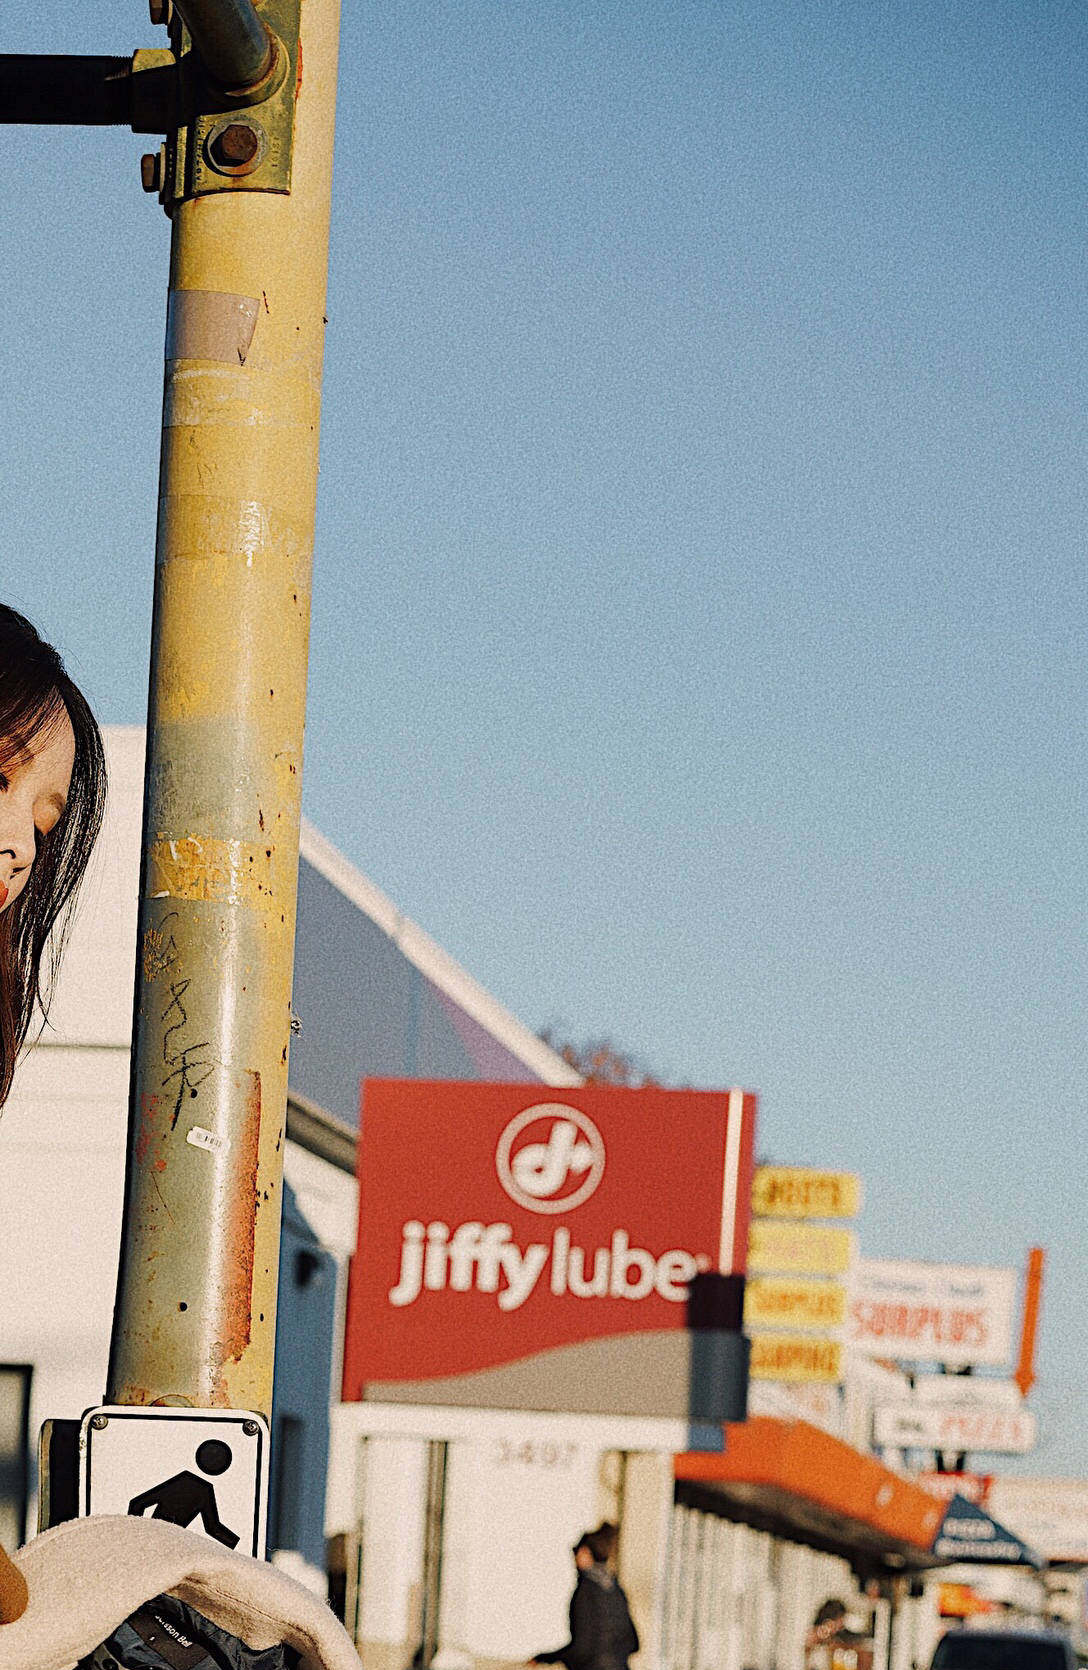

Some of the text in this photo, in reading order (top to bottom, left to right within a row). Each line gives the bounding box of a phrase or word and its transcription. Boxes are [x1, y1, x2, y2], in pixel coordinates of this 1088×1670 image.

[388, 1219, 698, 1311] jiffy lube
[850, 1299, 989, 1348] SURPLUS
